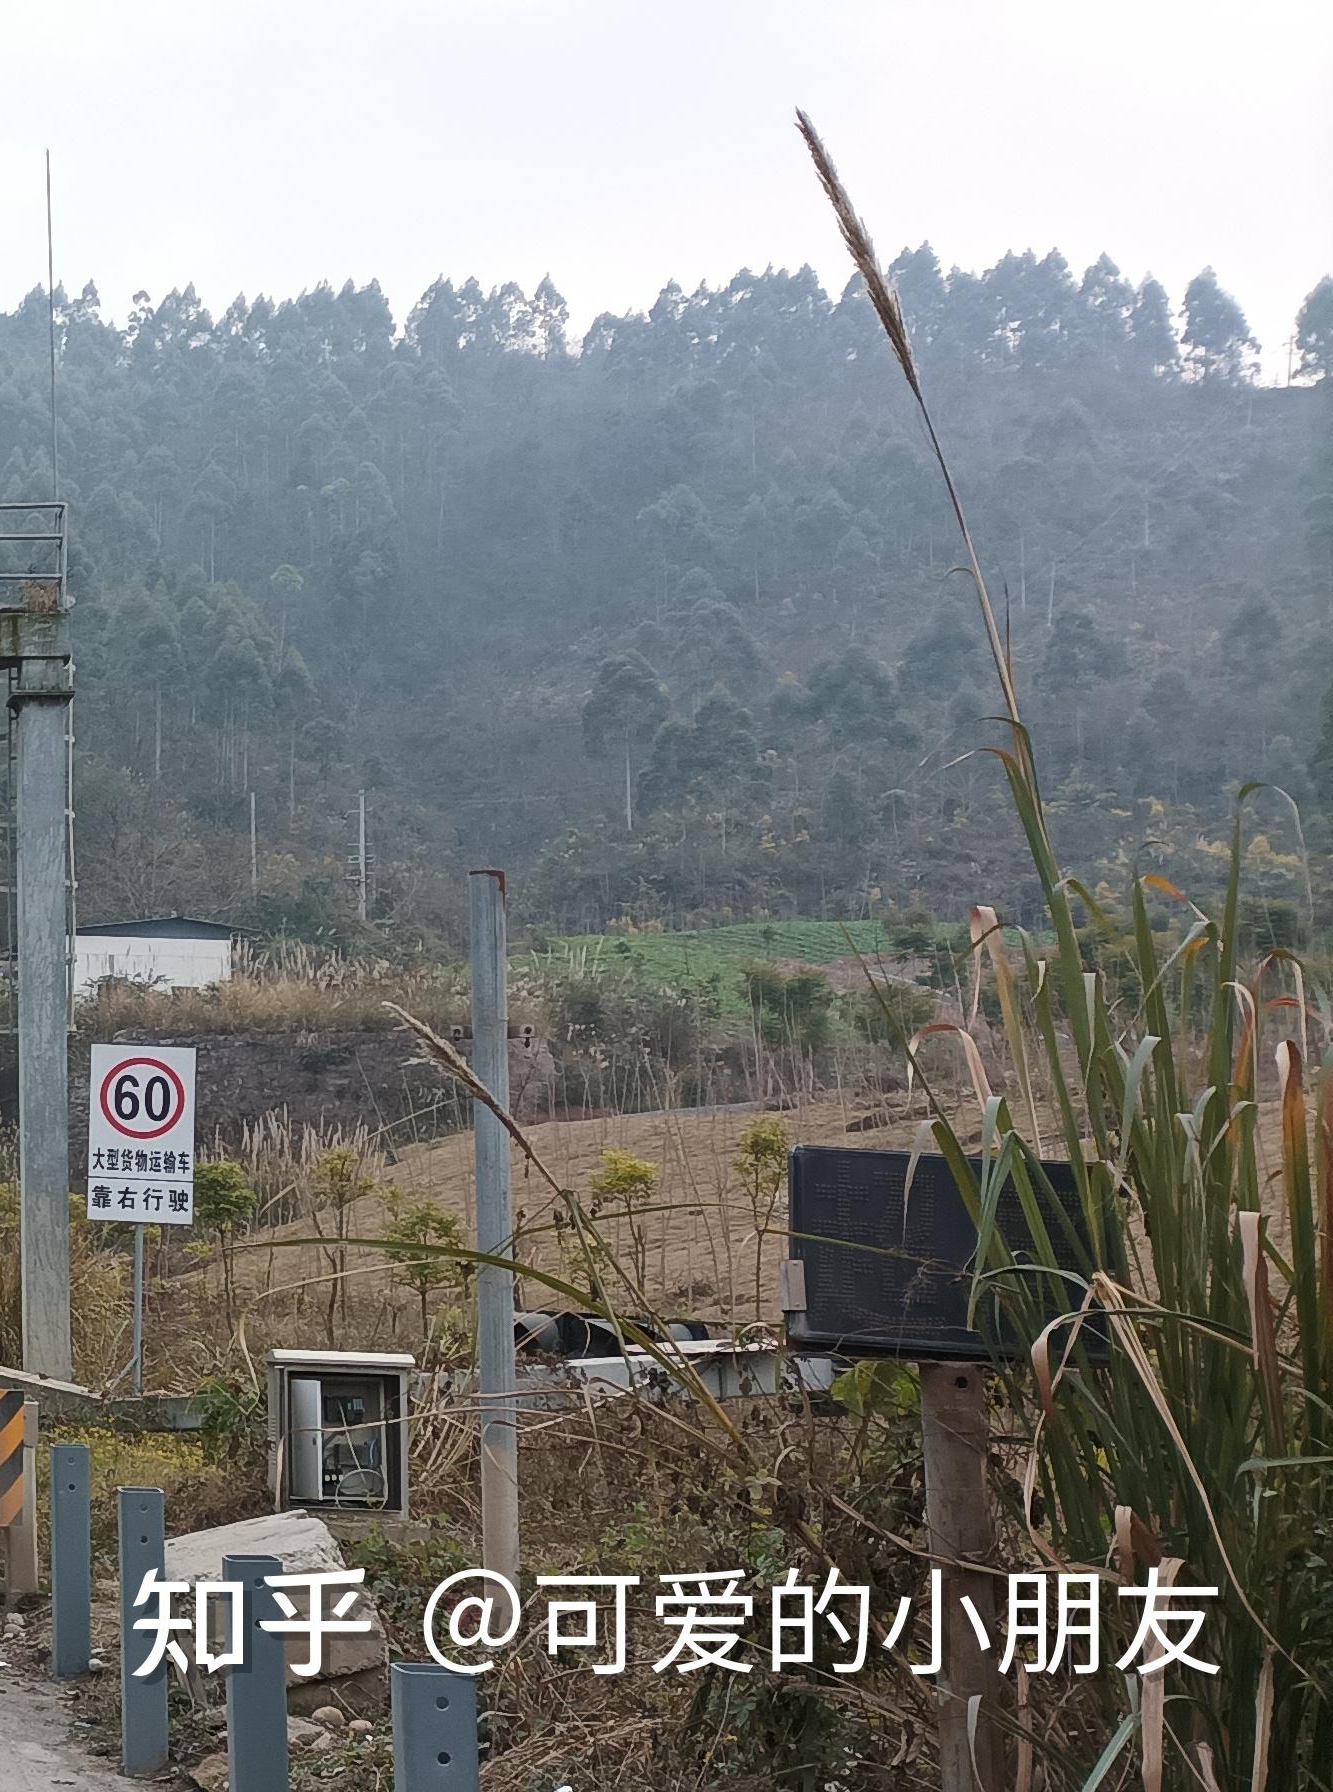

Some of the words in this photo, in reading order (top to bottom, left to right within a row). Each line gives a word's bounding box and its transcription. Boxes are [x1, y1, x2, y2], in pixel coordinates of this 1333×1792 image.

[114, 1074, 171, 1122] 60
[92, 1147, 191, 1175] 大型货物运输车
[91, 1185, 189, 1213] 靠右行驶
